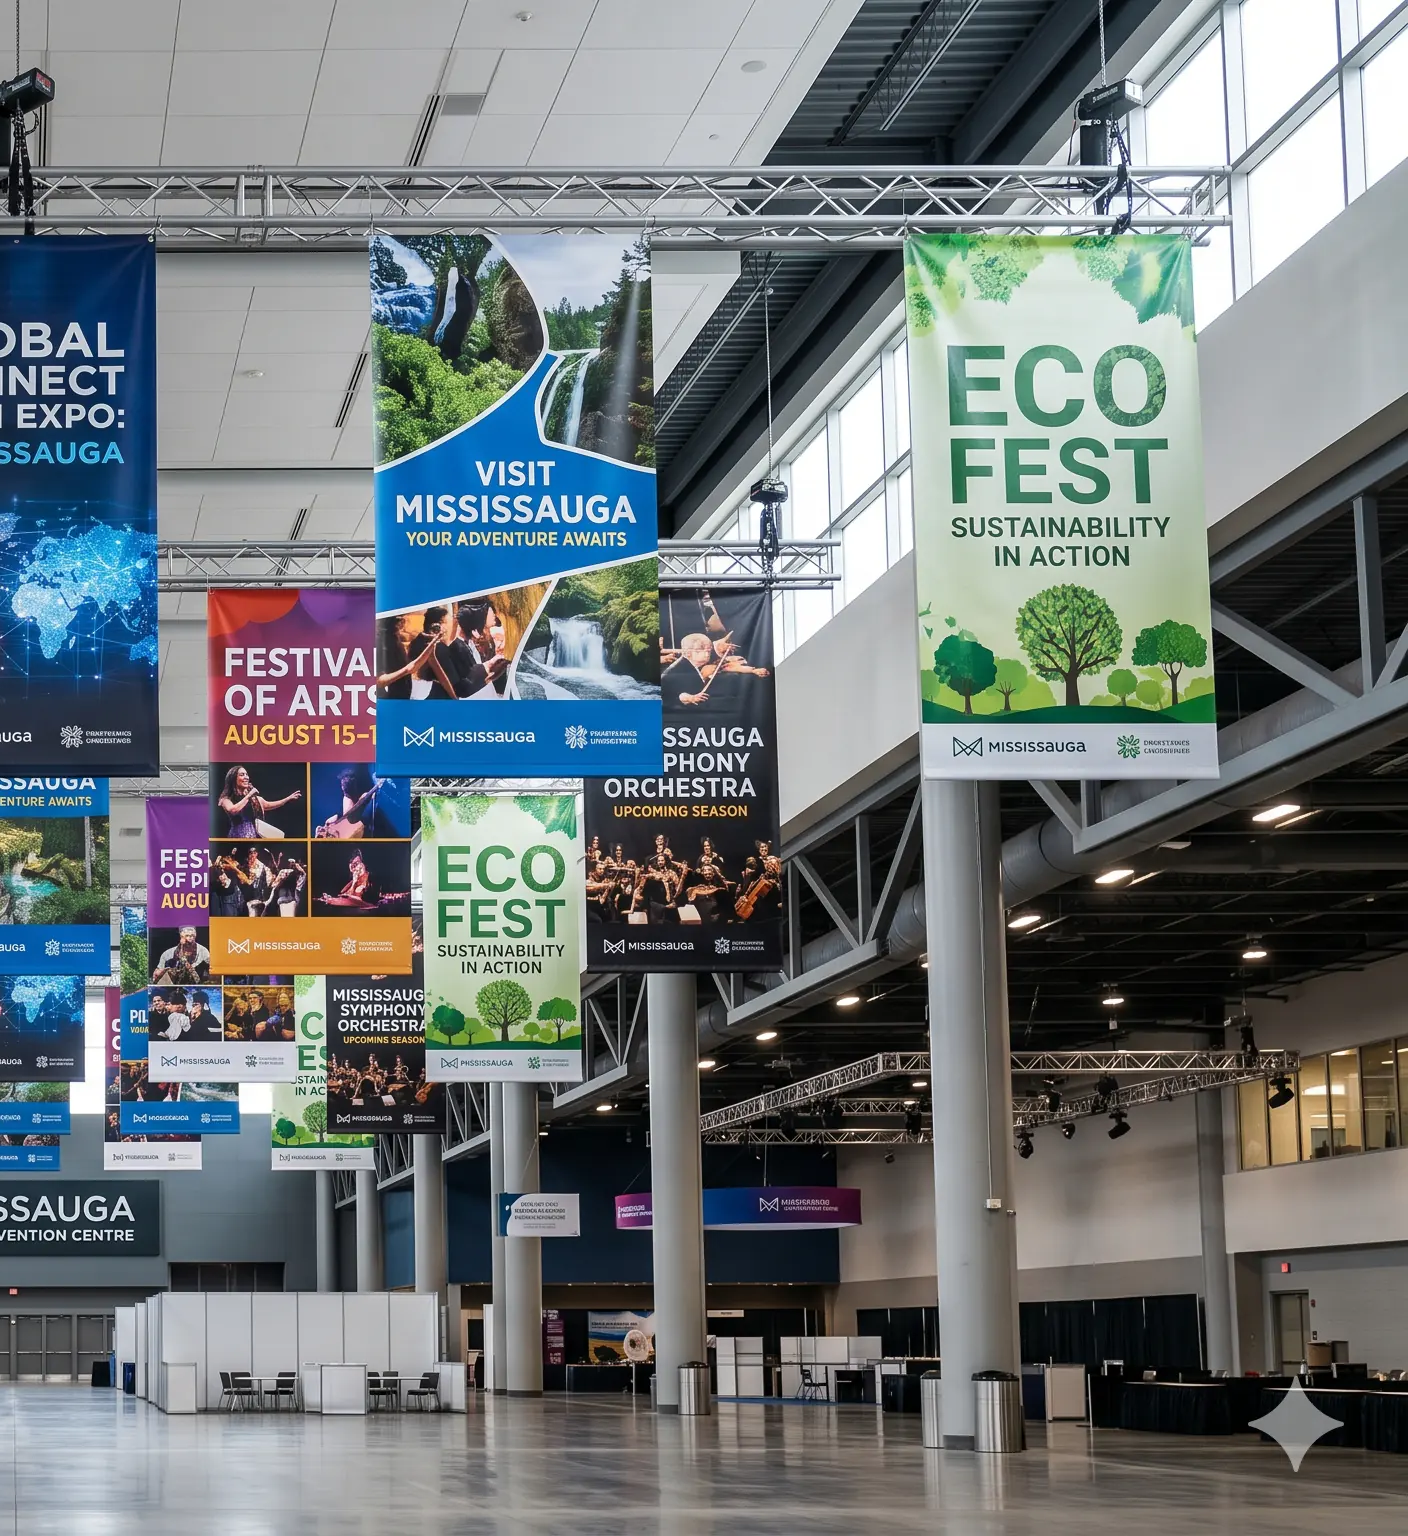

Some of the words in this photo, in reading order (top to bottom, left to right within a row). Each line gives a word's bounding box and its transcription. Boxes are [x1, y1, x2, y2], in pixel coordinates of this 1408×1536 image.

[947, 344, 1167, 428] ECO
[17, 403, 125, 429] EXPO:
[475, 461, 555, 486] VISIT
[949, 436, 1169, 505] FEST
[396, 495, 636, 524] MISSISSAUGA
[951, 516, 1171, 538] SUSTAINABILITY
[406, 531, 452, 547] YOUR
[457, 531, 558, 547] ADVENTURE
[563, 531, 627, 547] AWAITS
[994, 545, 1019, 567] IN
[1030, 545, 1130, 567] ACTION
[225, 684, 277, 716] OF
[224, 724, 324, 745] AUGUST
[663, 727, 764, 747] SSAUGA
[663, 753, 750, 772] PHONY
[604, 777, 756, 798] ORCHESTRA
[48, 796, 92, 806] AWAITS
[614, 805, 688, 817] UPCOMING
[692, 805, 747, 817] SEASON
[438, 844, 566, 893] ECO
[160, 872, 186, 888] OF
[161, 893, 209, 908] AUGU
[437, 899, 566, 939] FEST
[437, 944, 564, 957] SUSTAINABILITY
[461, 961, 477, 974] IN
[483, 961, 542, 974] ACTION
[333, 989, 423, 1001] MISSISSAUG
[340, 1004, 425, 1016] SYMPHONY
[338, 1019, 425, 1032] ORCHESTRA
[391, 1036, 425, 1044] SEASON
[71, 1229, 134, 1242] CENTRE
